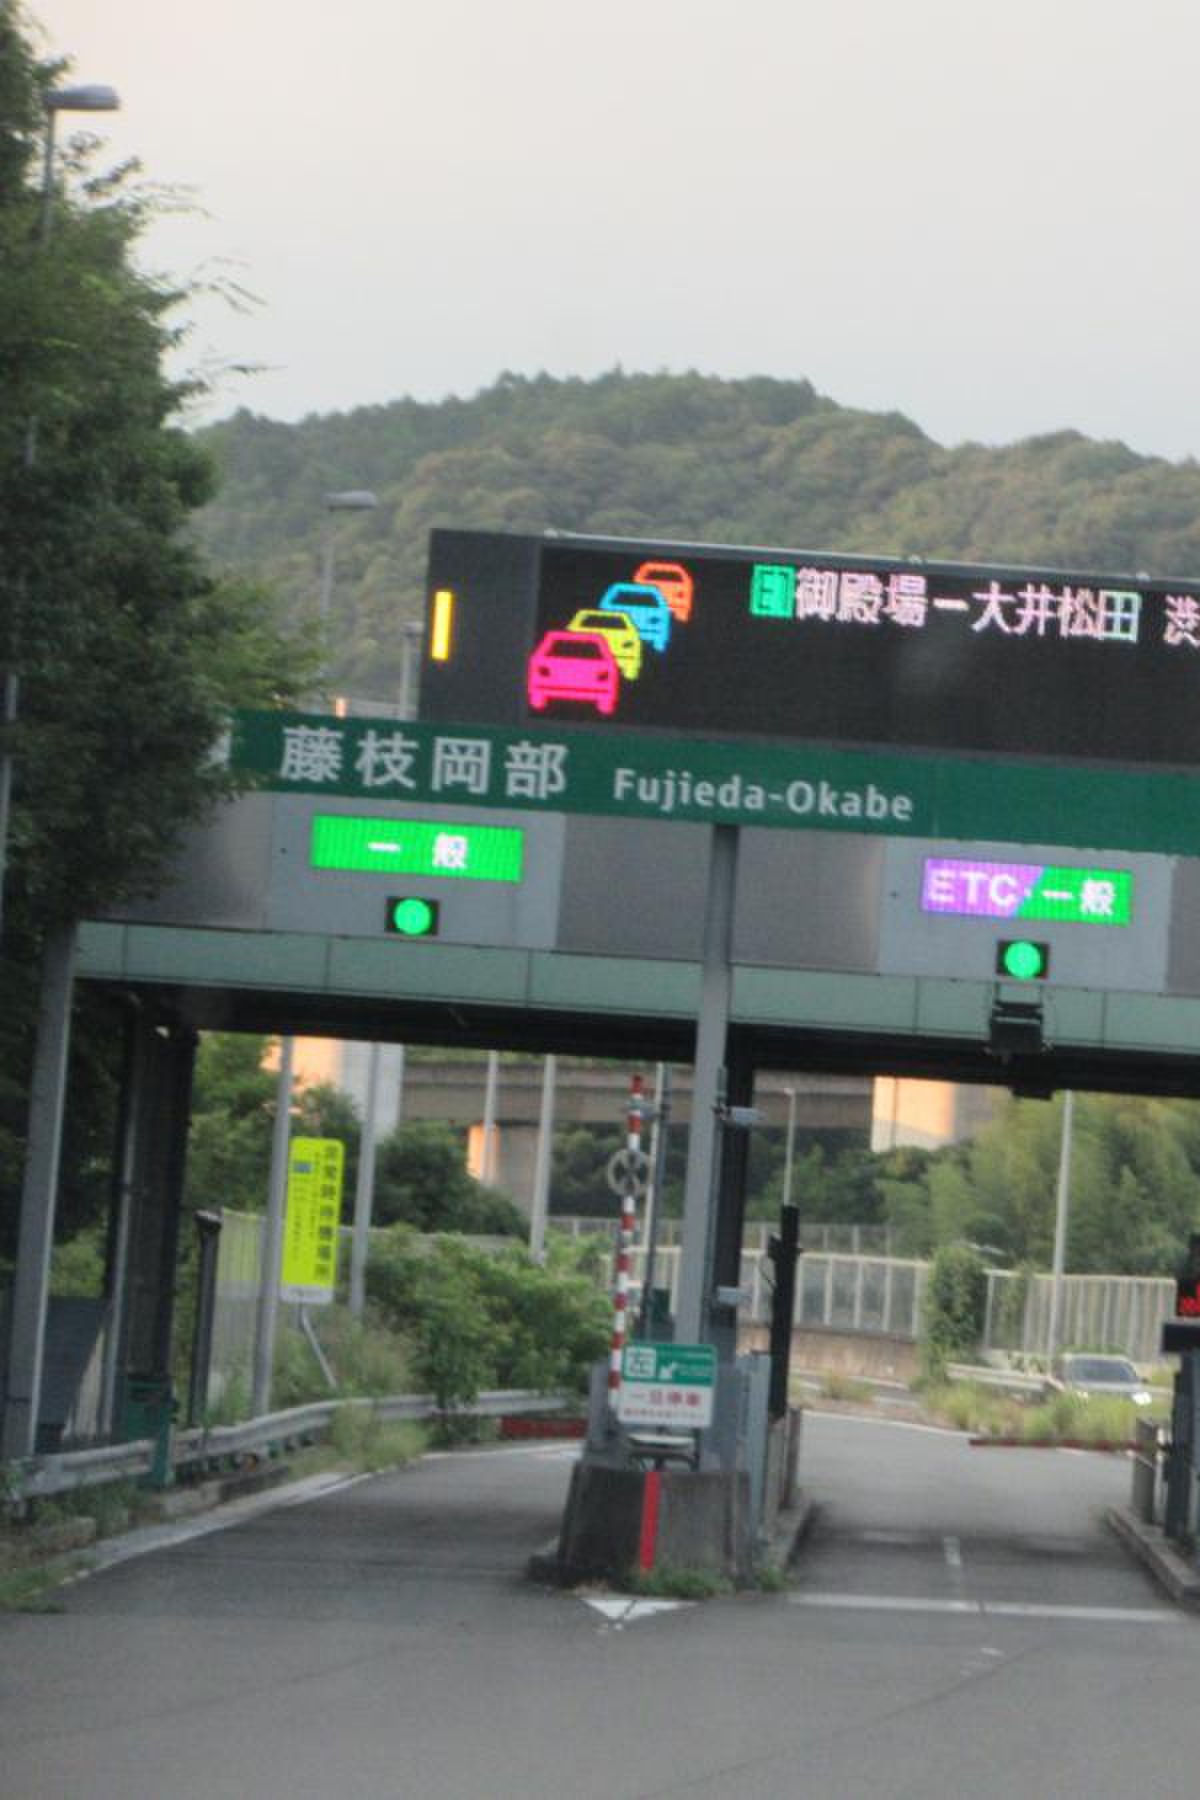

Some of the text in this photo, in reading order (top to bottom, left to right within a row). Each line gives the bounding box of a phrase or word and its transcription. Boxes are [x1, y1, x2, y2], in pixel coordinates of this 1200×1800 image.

[281, 726, 568, 799] 藤枝岡部
[613, 767, 914, 823] Fujieda-Okabe
